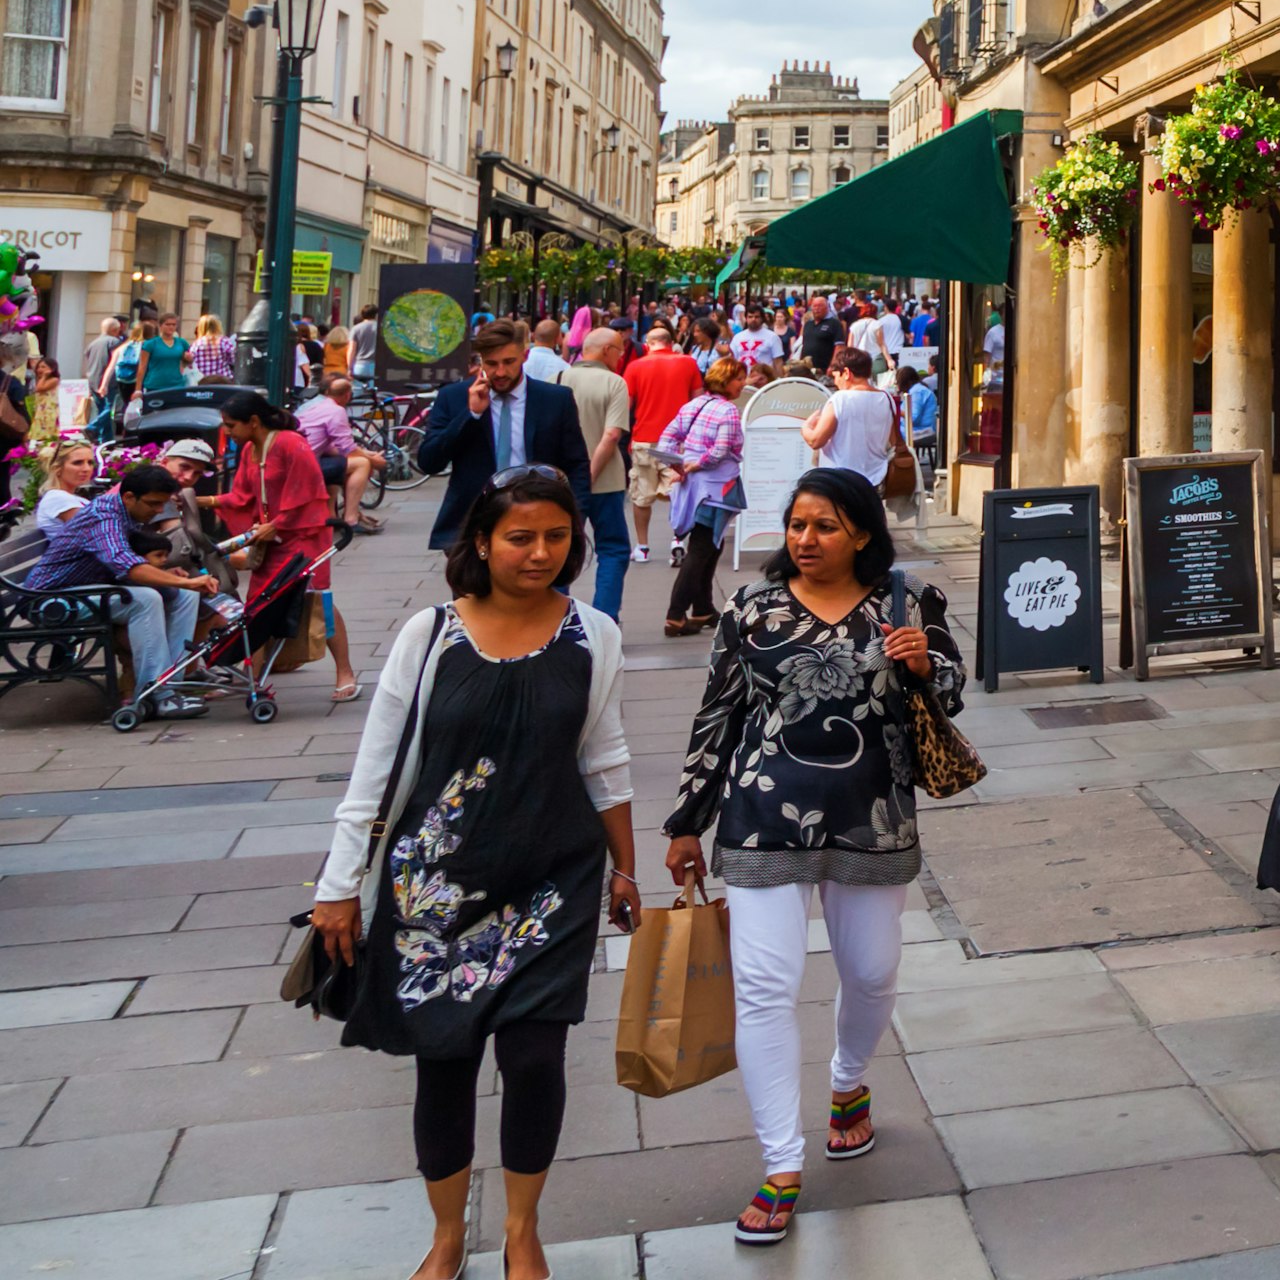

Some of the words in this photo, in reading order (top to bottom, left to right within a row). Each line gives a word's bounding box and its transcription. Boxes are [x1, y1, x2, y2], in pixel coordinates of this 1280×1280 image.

[1169, 475, 1219, 505] JACOB'S
[1174, 511, 1222, 524] SMOOTHIES
[1015, 580, 1041, 597] LIVE
[1040, 575, 1067, 595] &
[1025, 596, 1047, 612] EAT
[1049, 593, 1069, 609] PIE
